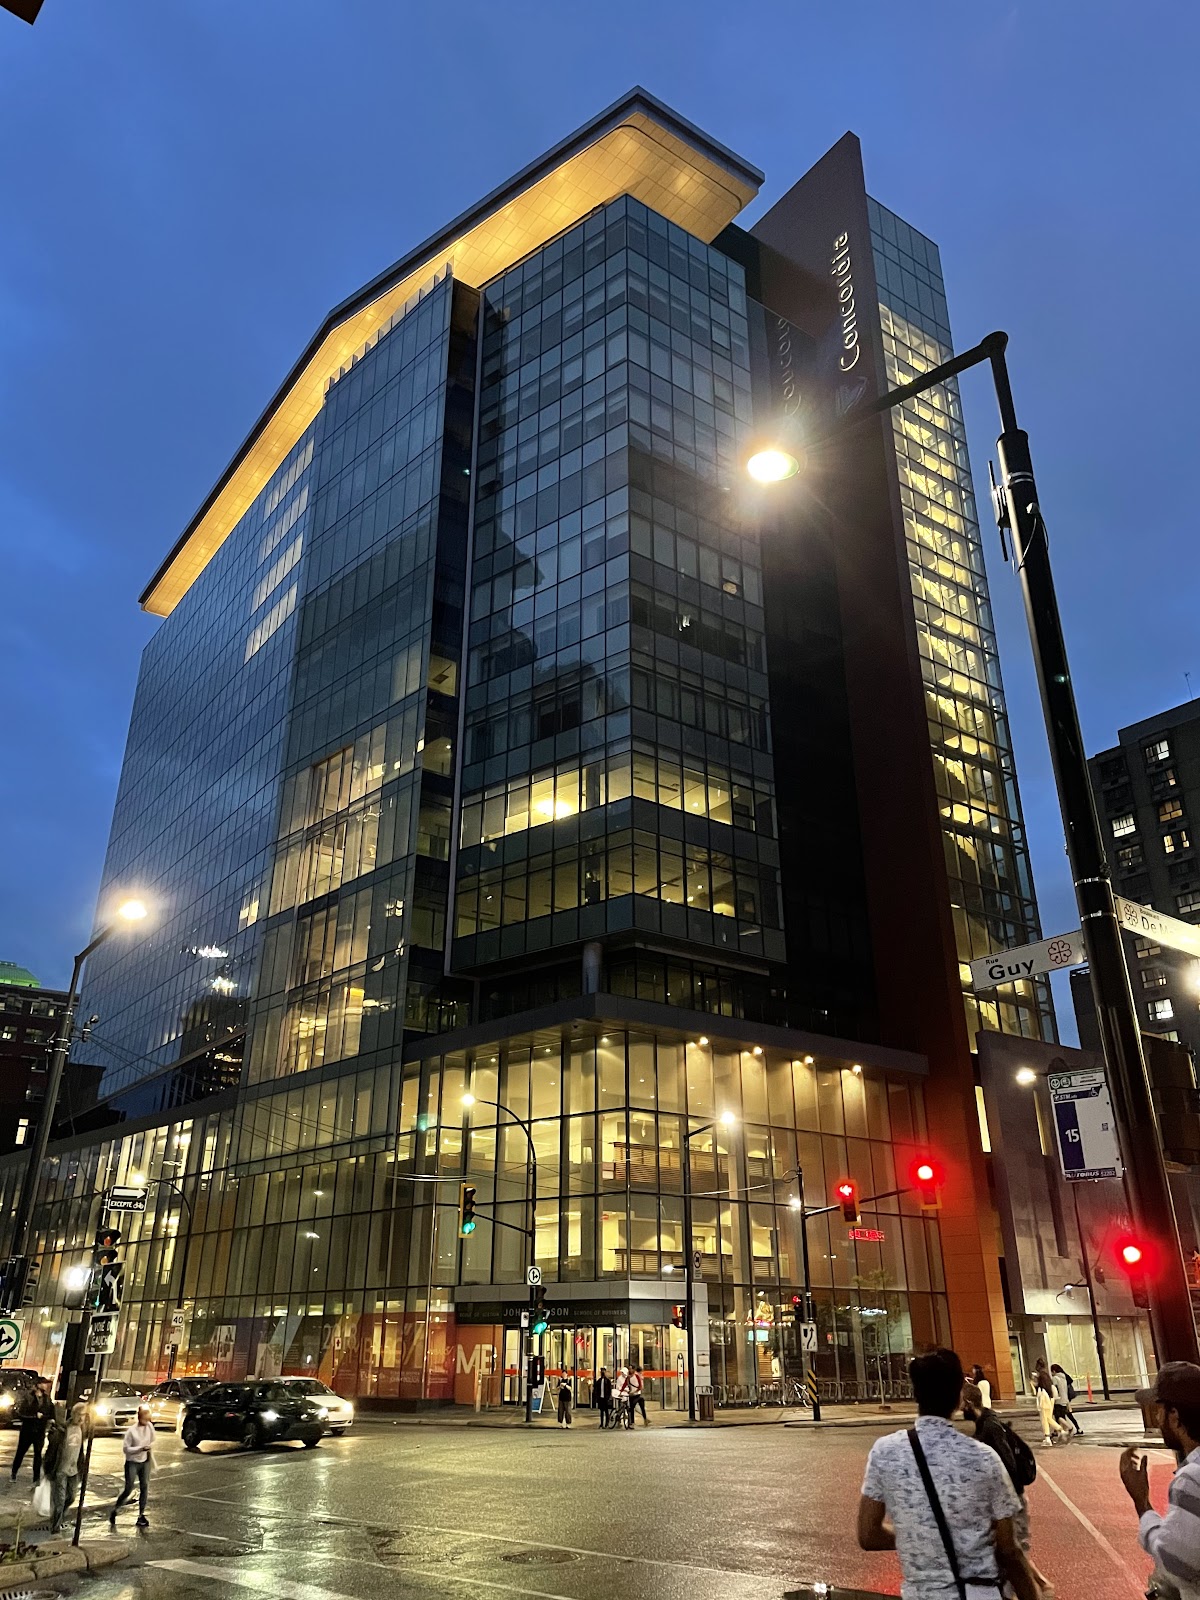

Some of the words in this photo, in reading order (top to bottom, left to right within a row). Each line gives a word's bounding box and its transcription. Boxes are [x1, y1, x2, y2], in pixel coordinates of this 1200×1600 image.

[831, 232, 860, 372] Concordia
[1141, 916, 1157, 934] De
[988, 959, 1034, 980] Guy
[1065, 1128, 1080, 1143] 15
[172, 1316, 184, 1325] 40
